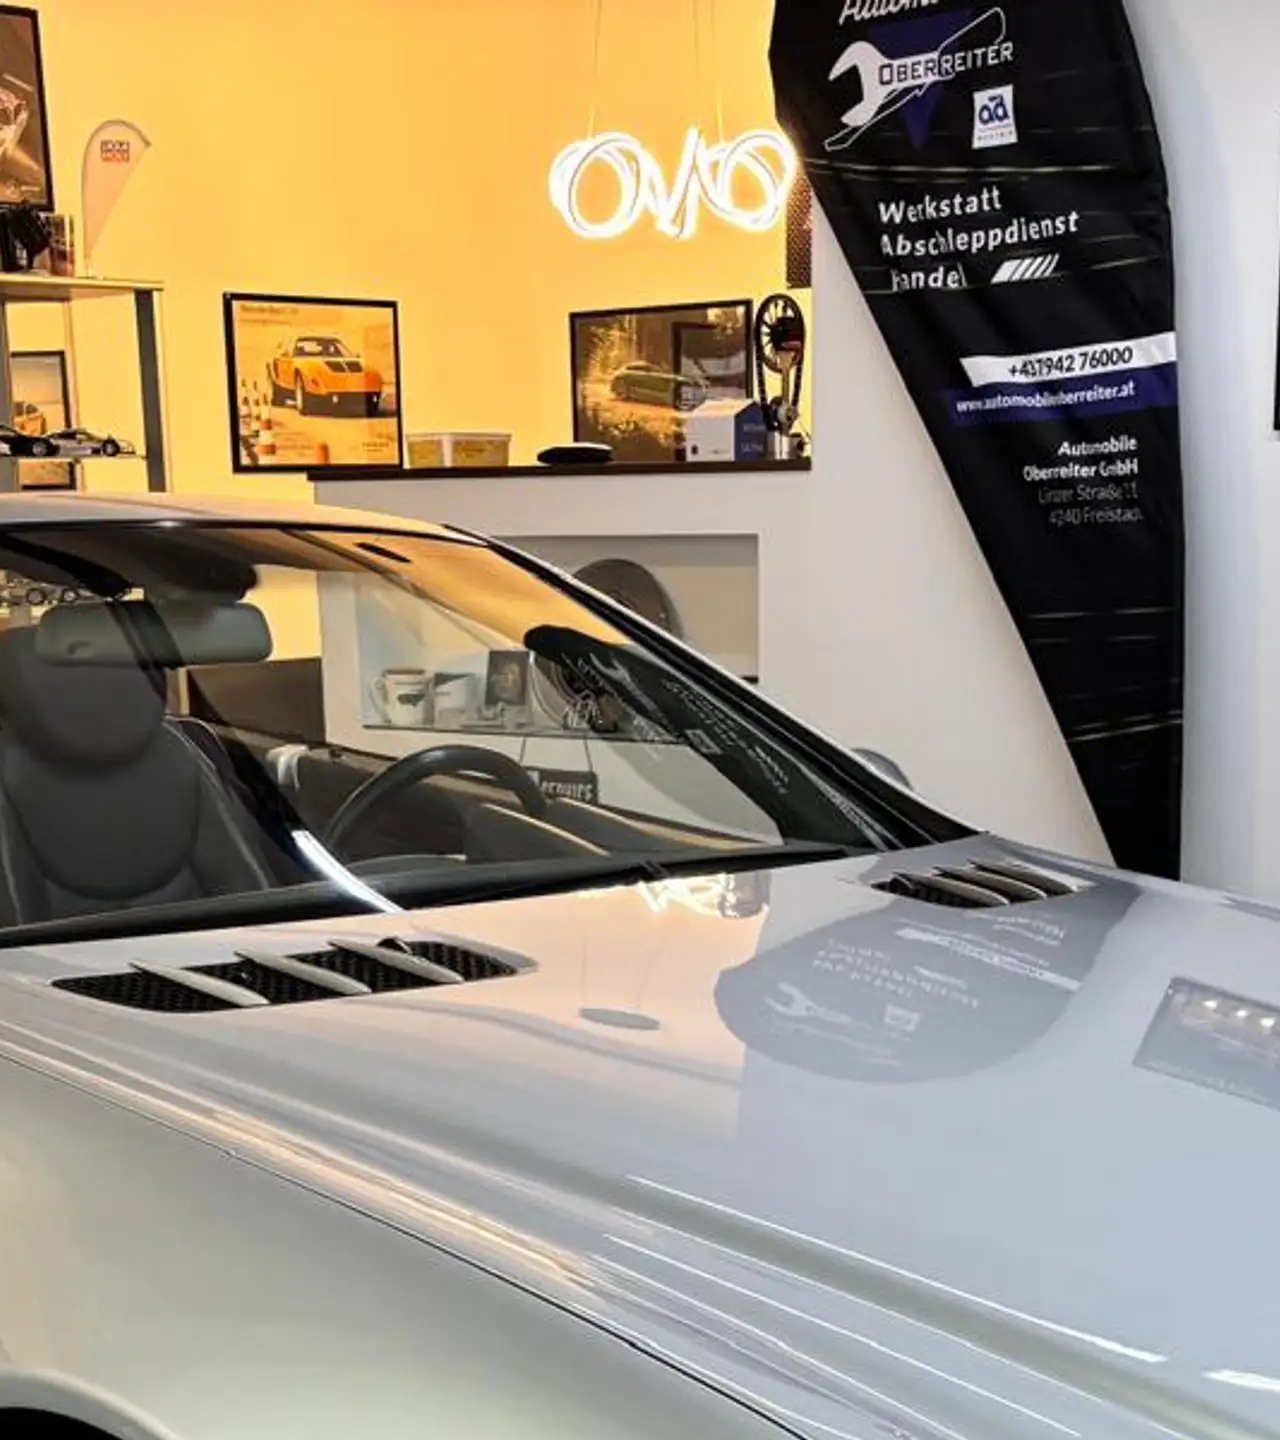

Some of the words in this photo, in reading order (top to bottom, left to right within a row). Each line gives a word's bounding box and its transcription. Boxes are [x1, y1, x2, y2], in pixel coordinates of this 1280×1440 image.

[879, 41, 1014, 86] OBERREITER
[877, 185, 1001, 225] Werkstatt
[880, 211, 1079, 258] Abschleppdienst
[1077, 346, 1134, 371] 76000
[1022, 461, 1098, 481] Oberreiter
